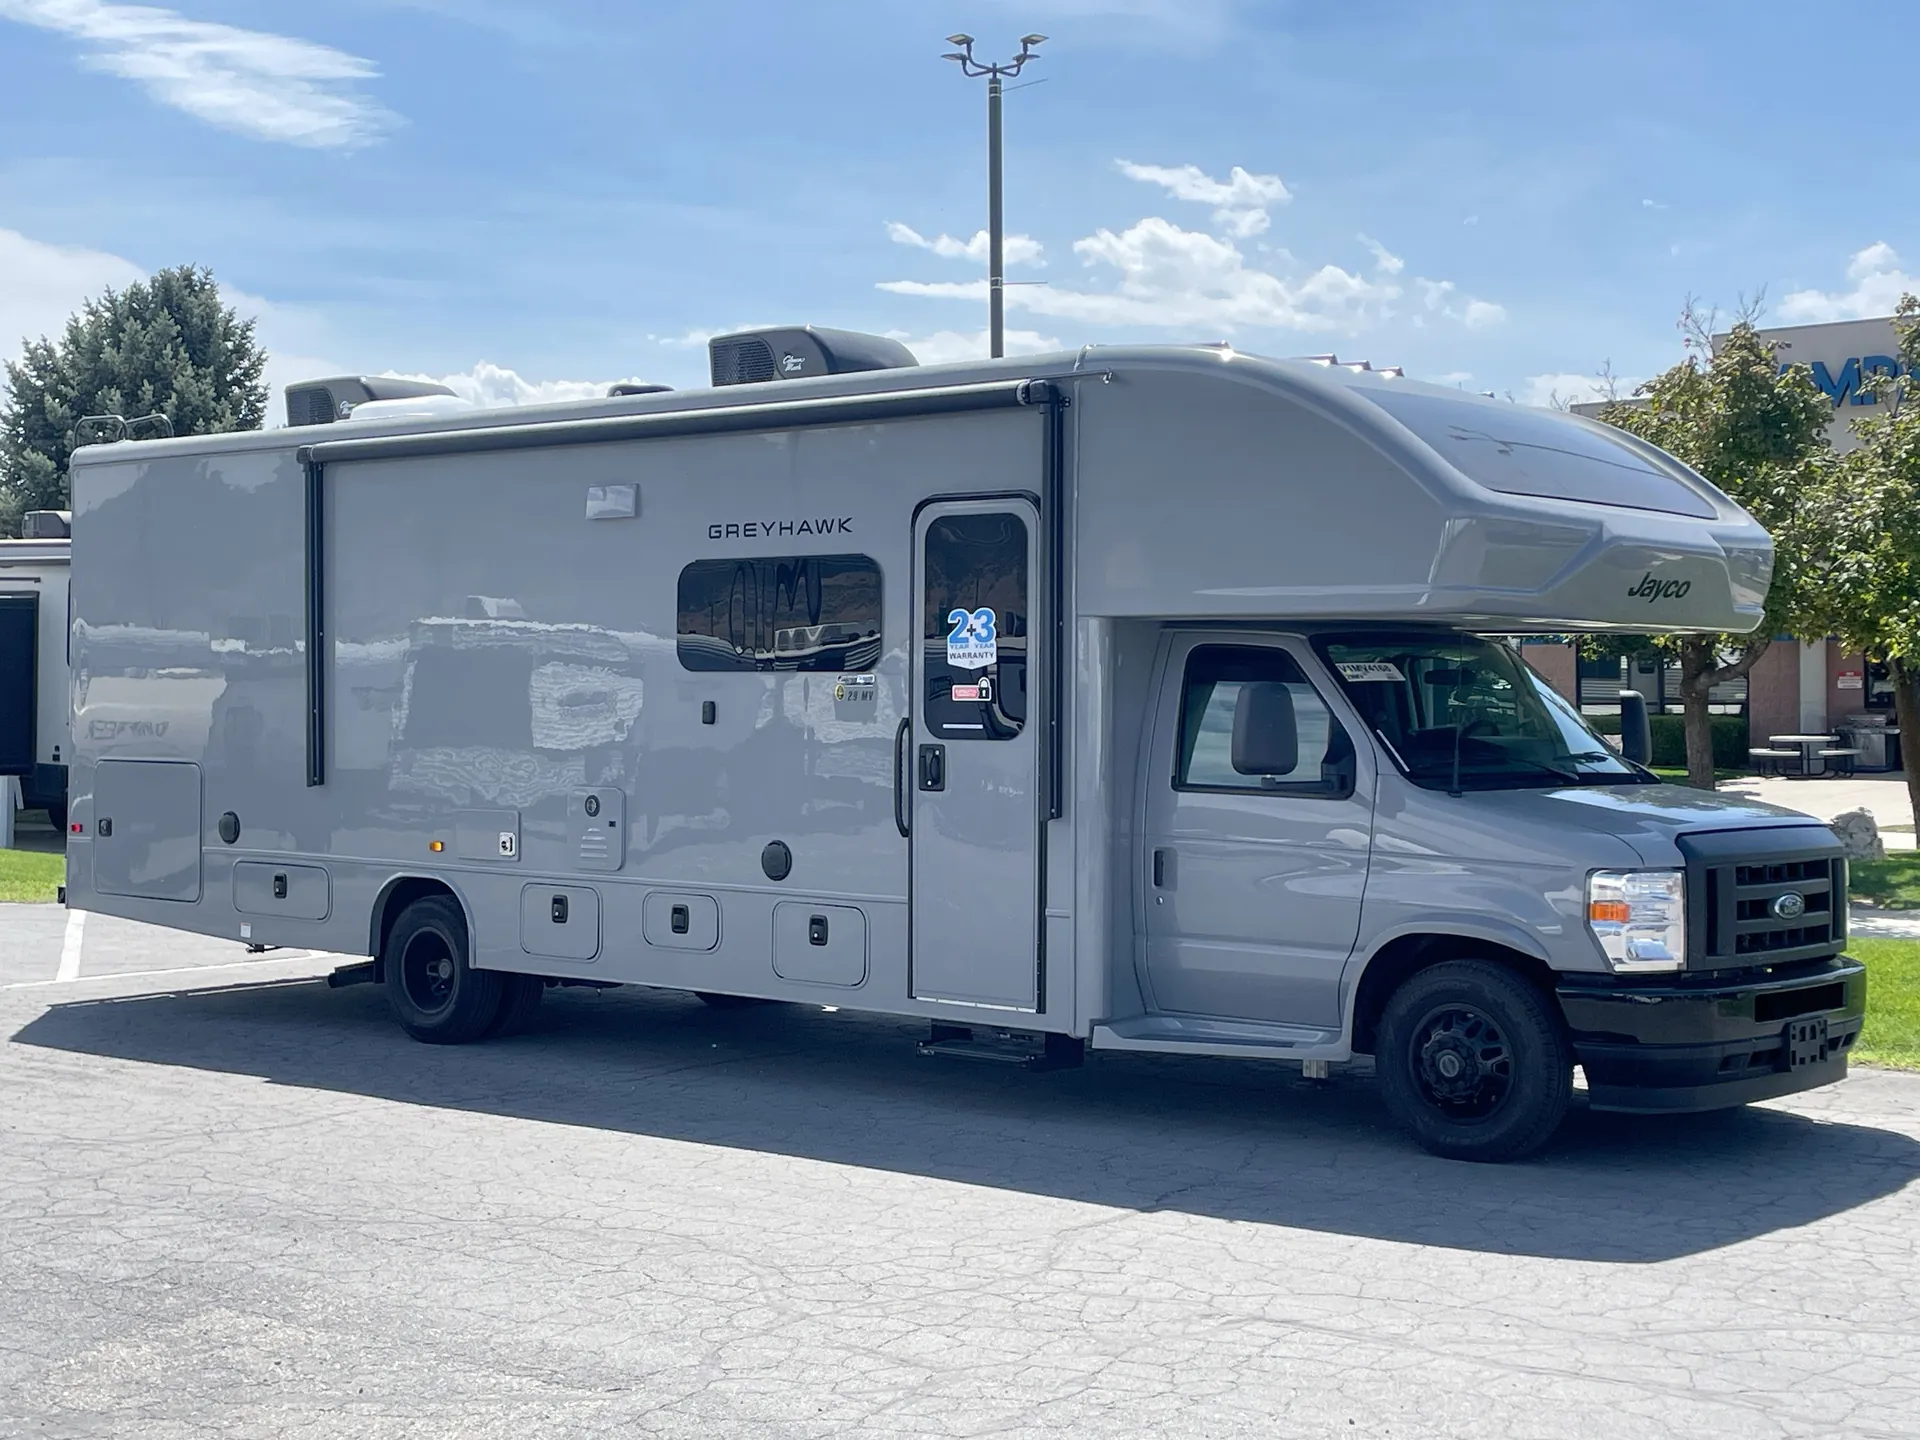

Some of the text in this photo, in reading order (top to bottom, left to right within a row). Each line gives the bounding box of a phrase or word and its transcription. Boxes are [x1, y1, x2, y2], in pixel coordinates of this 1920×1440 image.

[708, 517, 853, 539] GREYHAWK
[1628, 571, 1691, 603] Jayco
[949, 651, 995, 660] WARRANTY
